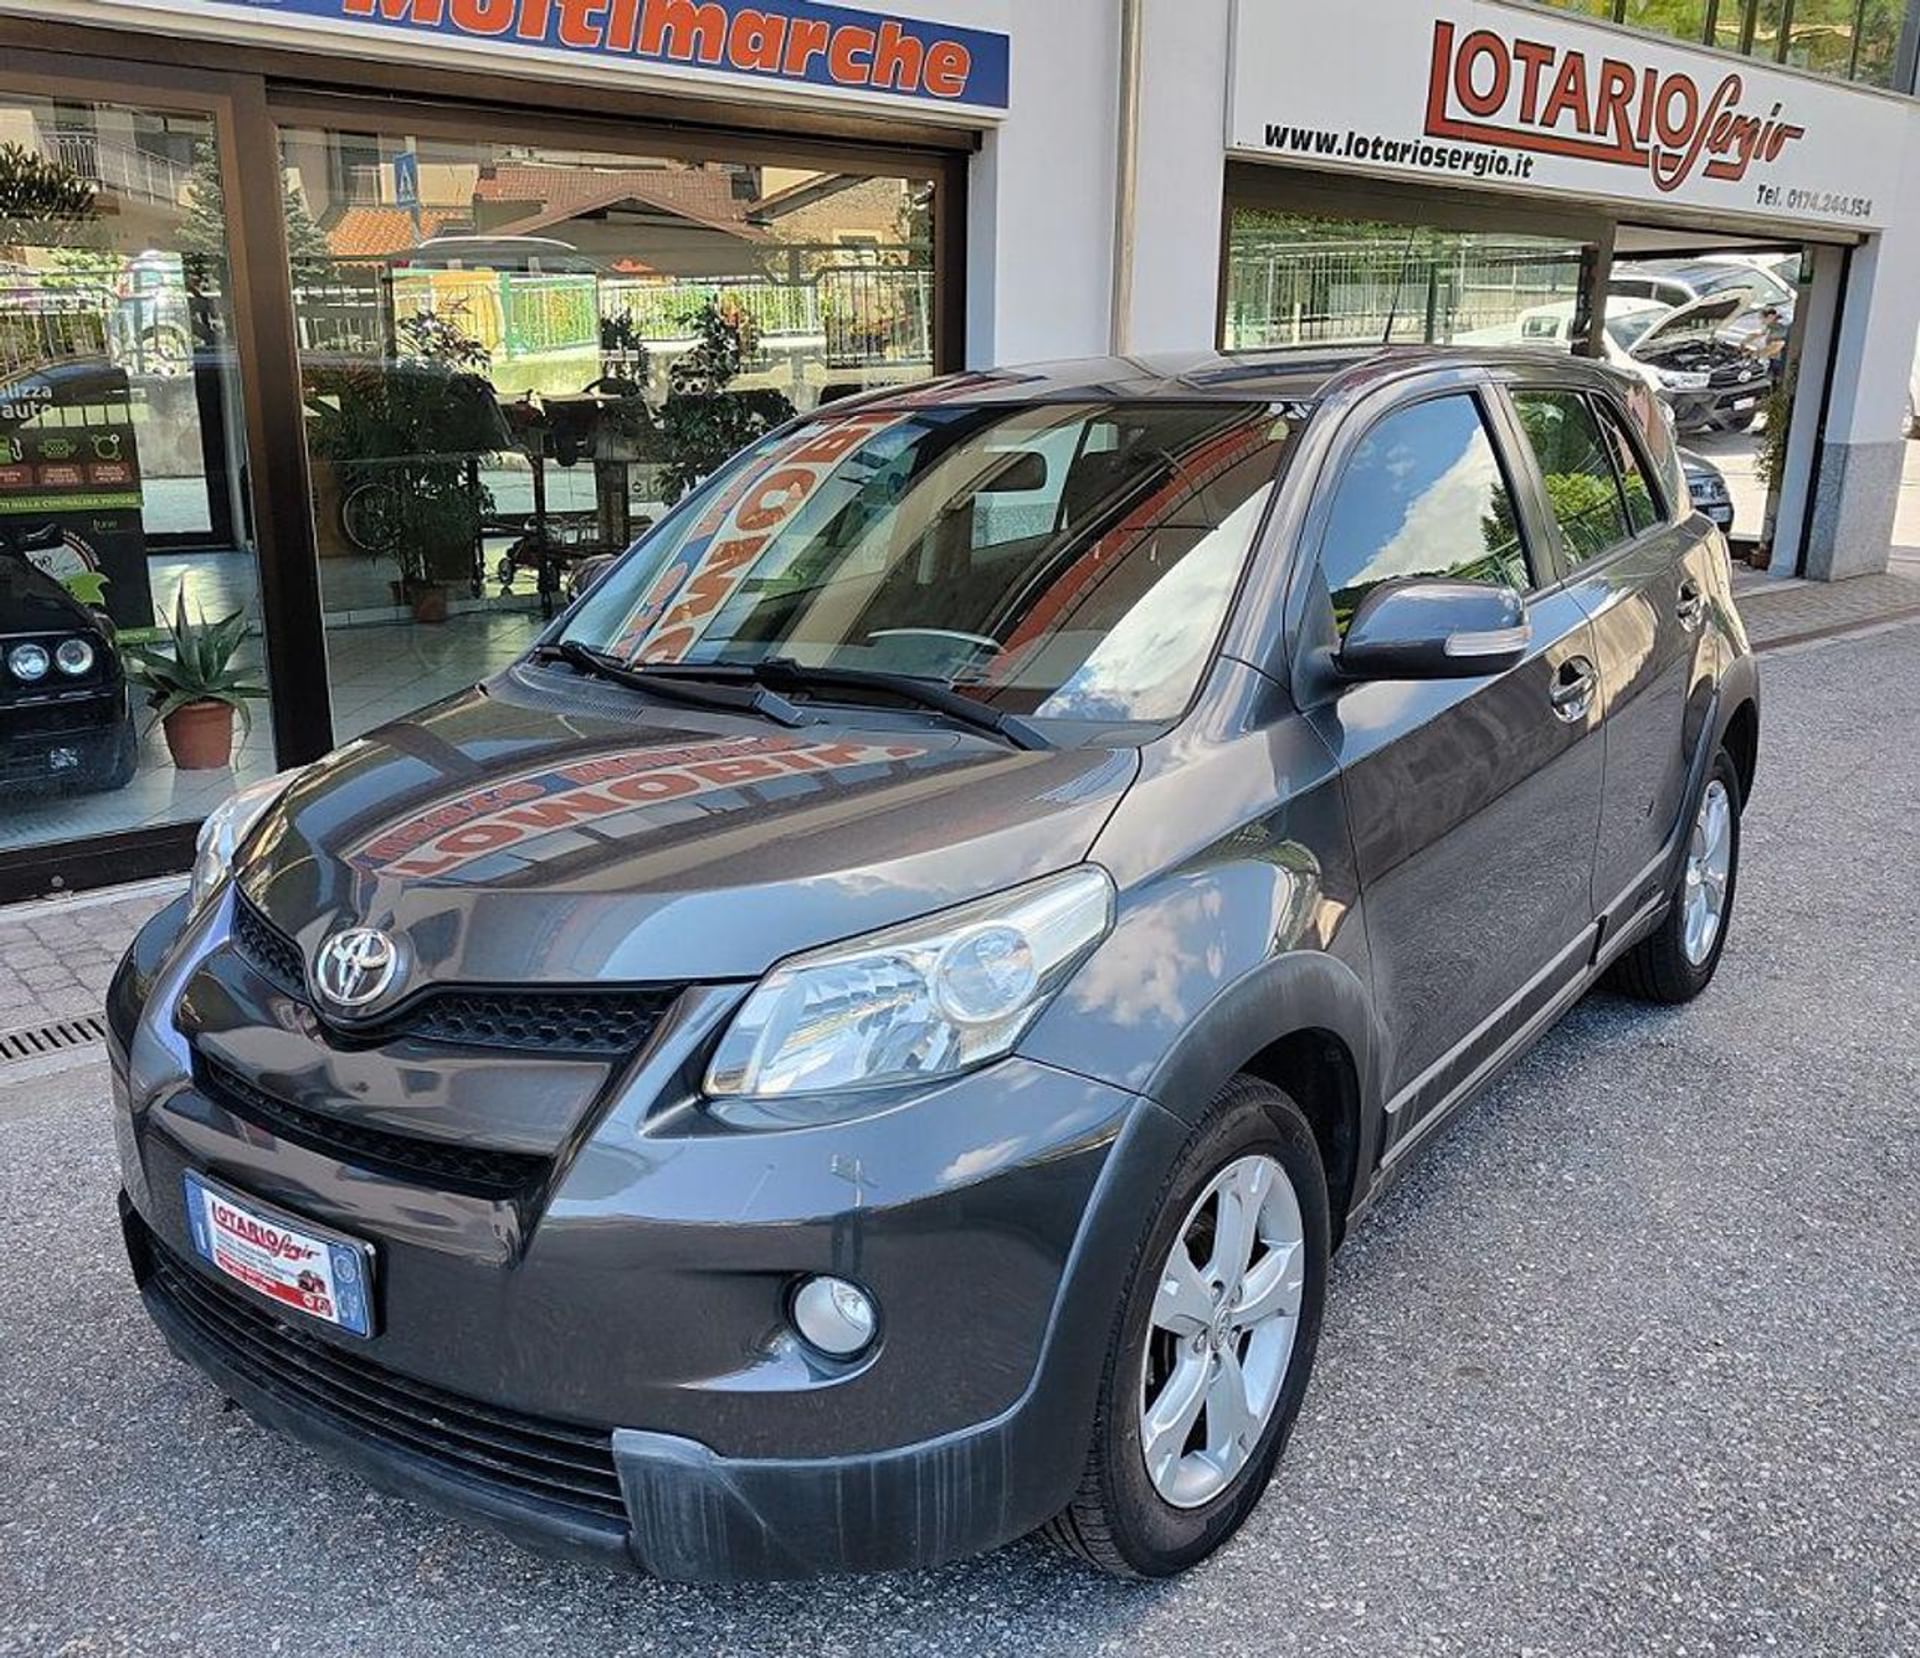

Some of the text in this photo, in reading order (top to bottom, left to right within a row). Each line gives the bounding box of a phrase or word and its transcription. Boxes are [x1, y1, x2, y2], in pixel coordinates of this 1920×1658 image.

[1424, 20, 1804, 192] LOTARIO Sergio
[1264, 123, 1535, 178] www.lotariosergio.it
[1756, 184, 1782, 207] Tel.
[212, 1200, 280, 1254] LOTARIO
